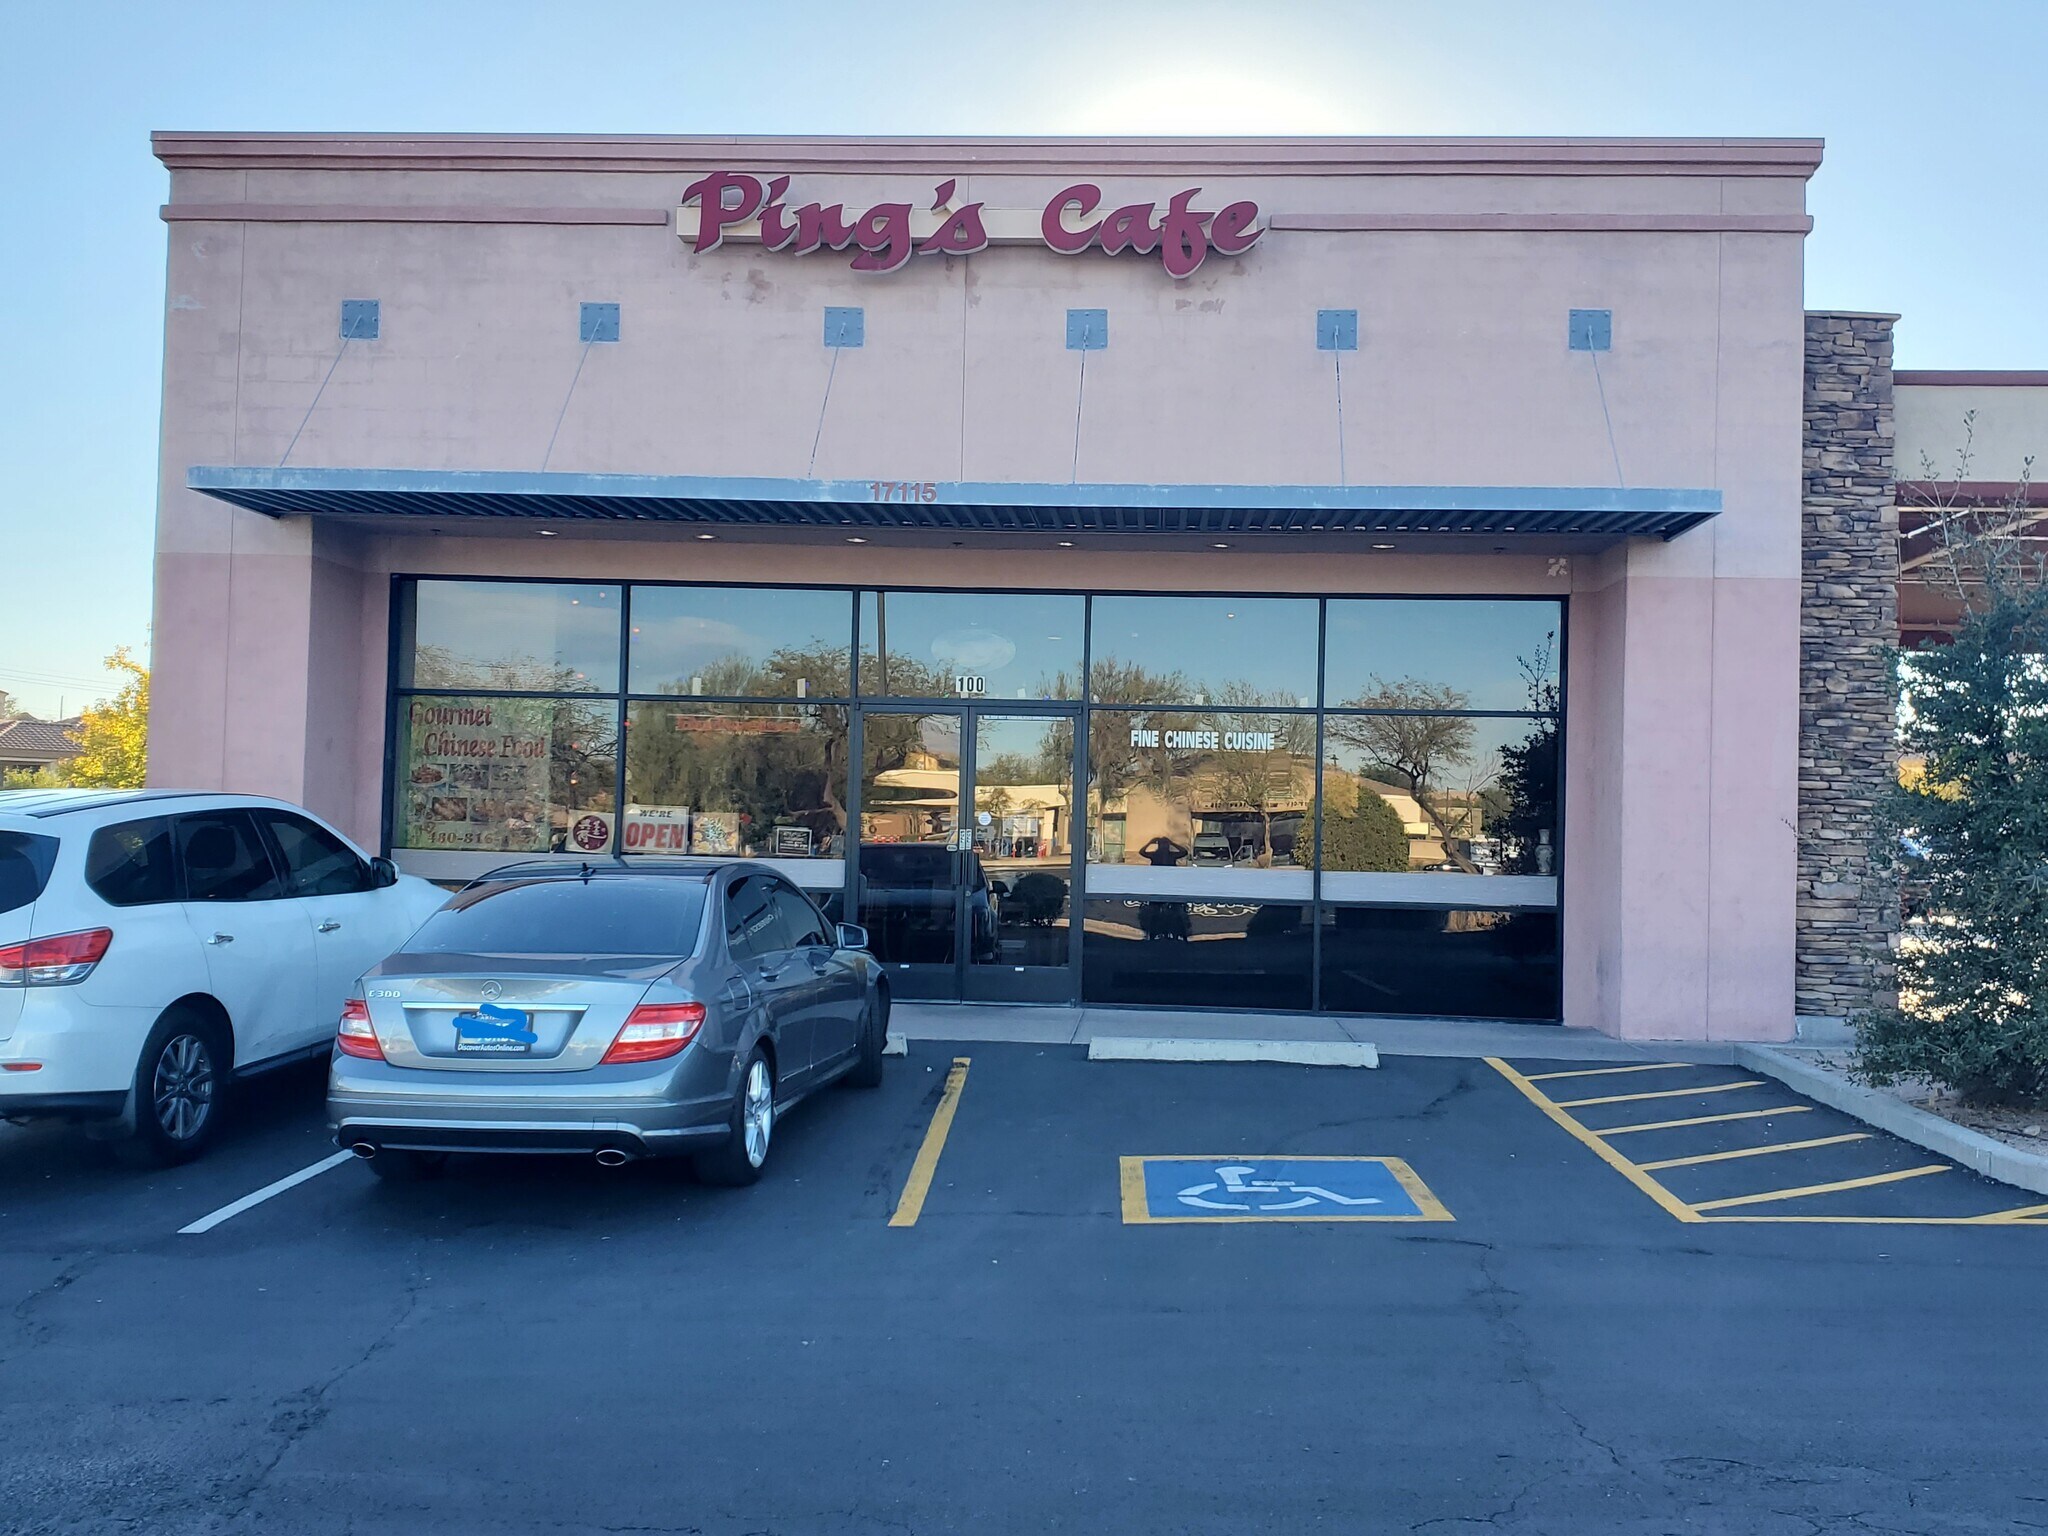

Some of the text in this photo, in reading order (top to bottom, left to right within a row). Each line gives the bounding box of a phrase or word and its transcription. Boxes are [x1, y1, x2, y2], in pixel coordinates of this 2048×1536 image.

[681, 169, 1266, 280] Ping's Cafe
[870, 482, 937, 502] 17115
[958, 677, 984, 692] 100
[409, 701, 492, 726] Gourmet
[422, 730, 547, 758] Chinese Food
[1130, 730, 1276, 750] FINE CHINESE CUISINE
[639, 809, 673, 818] WE'RE
[625, 822, 685, 849] OPEN
[457, 1043, 526, 1052] DiscoverAutosOnline.com
